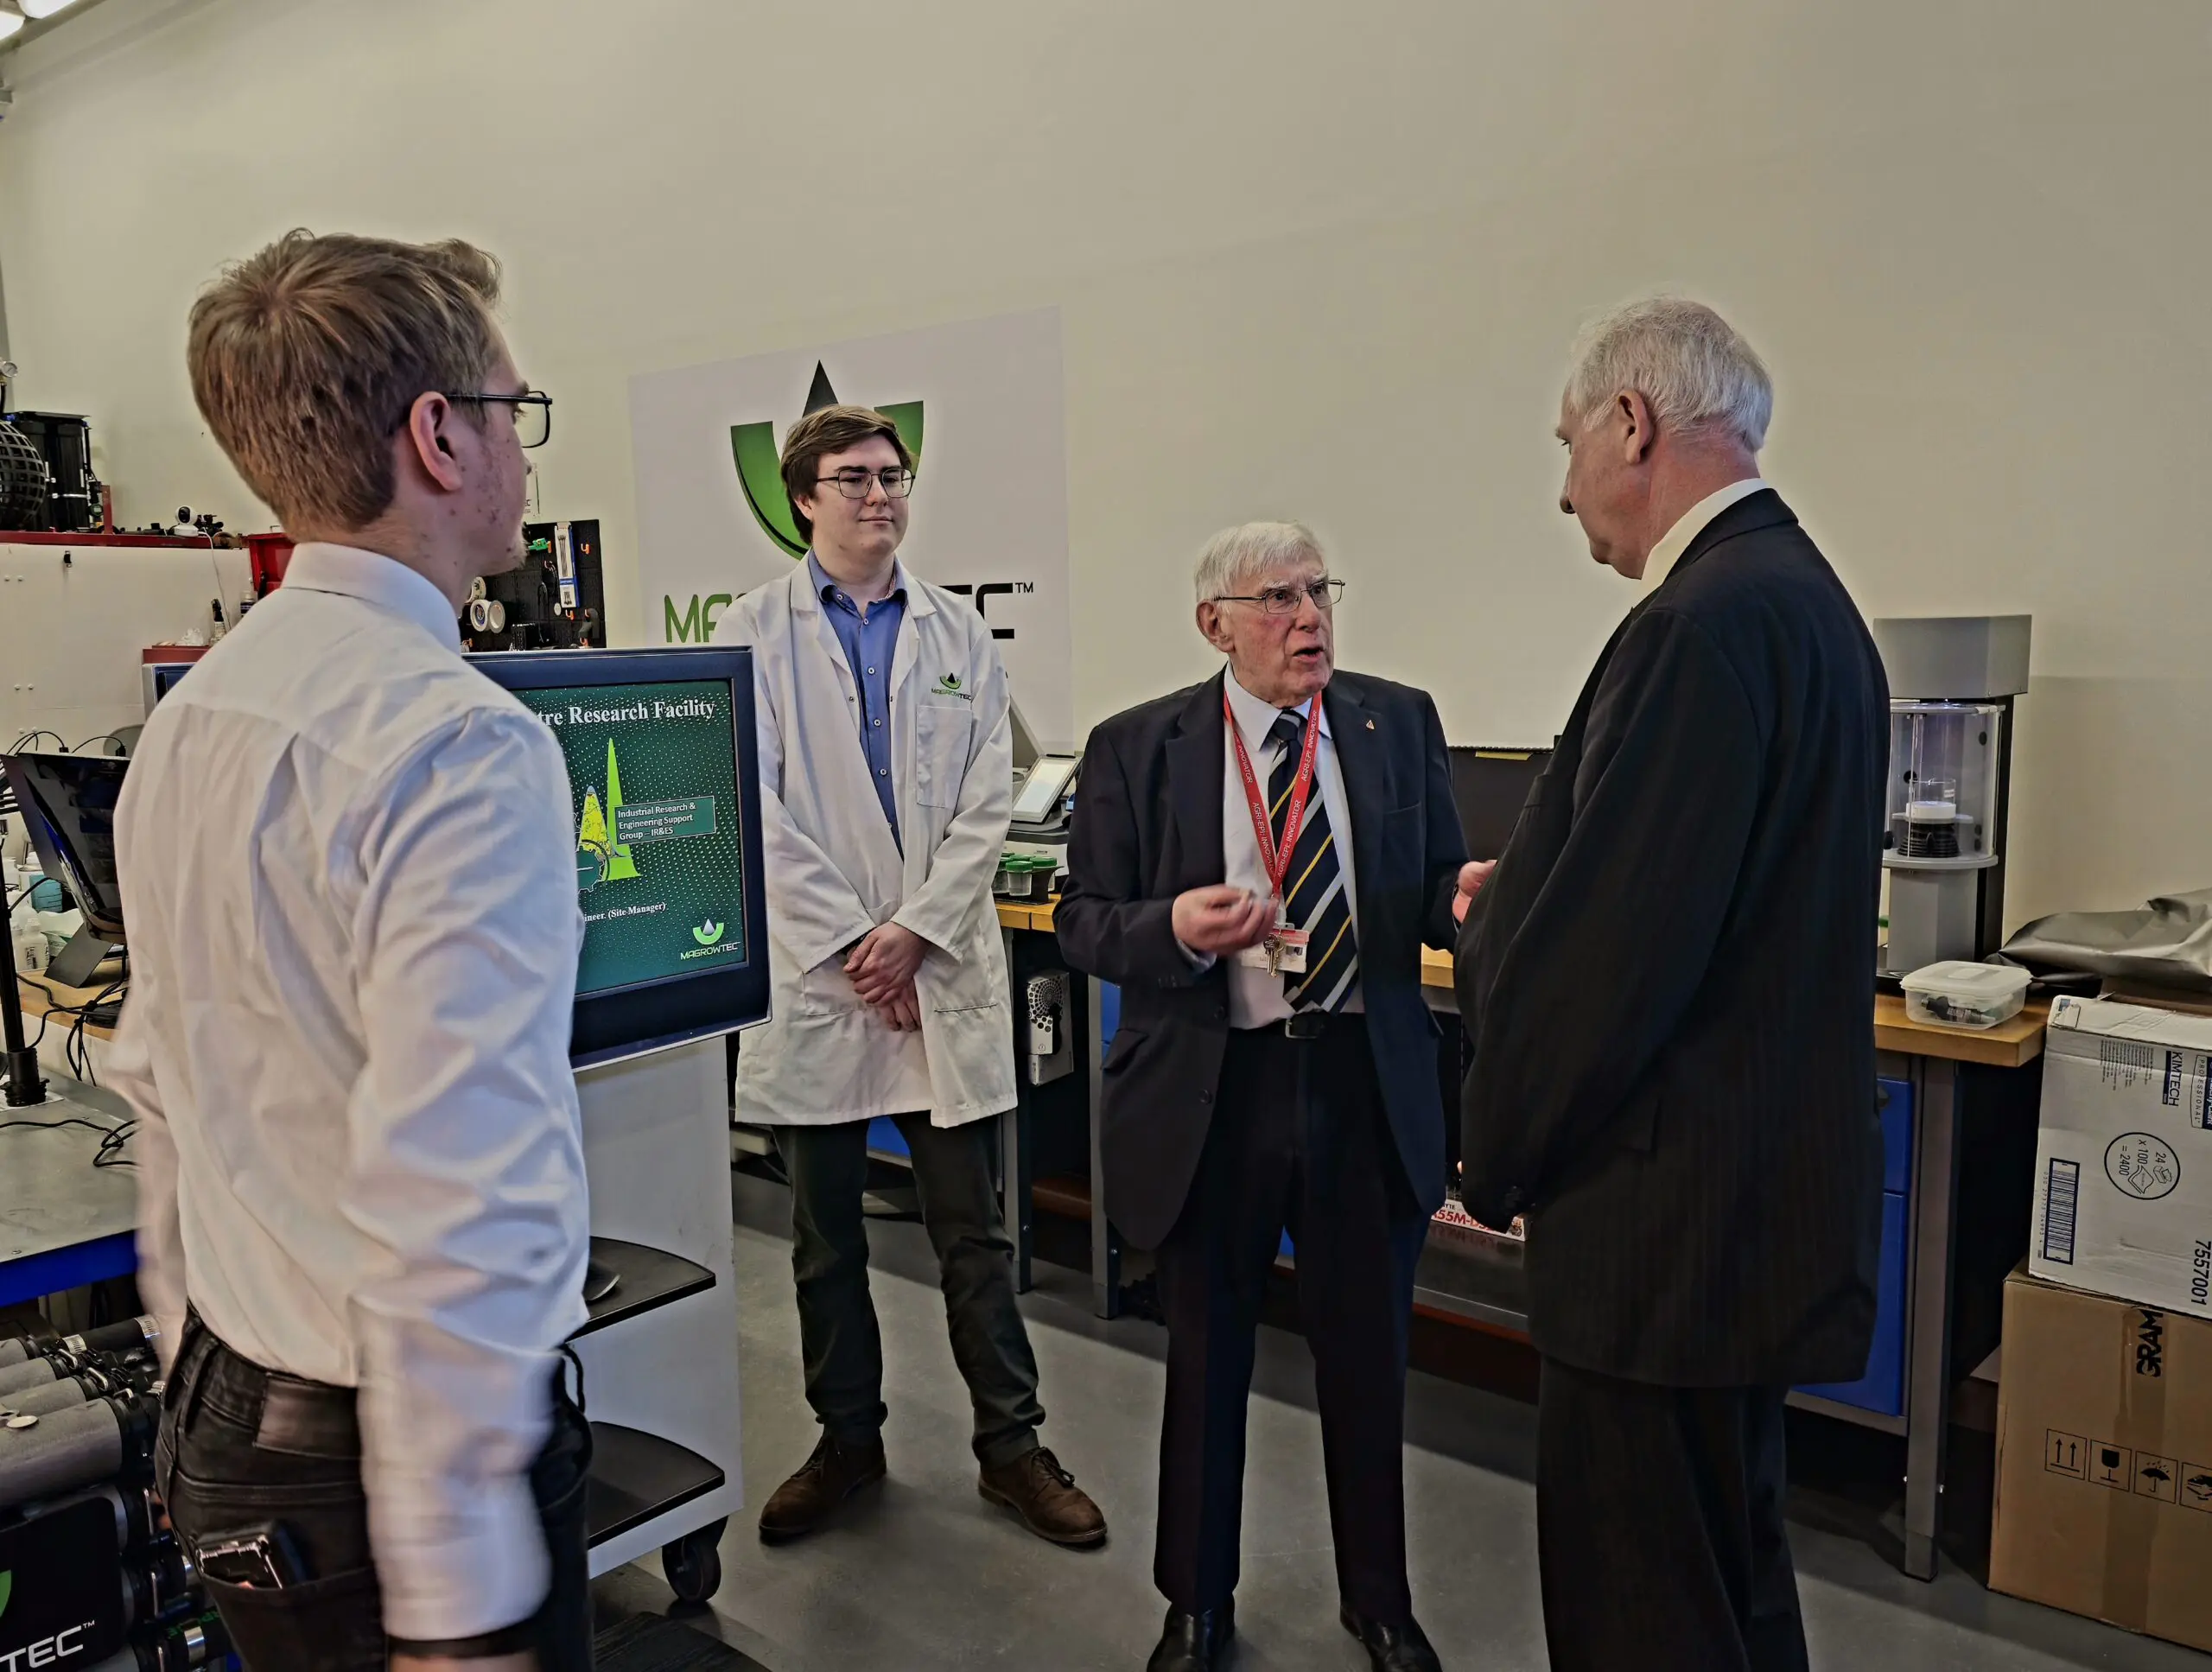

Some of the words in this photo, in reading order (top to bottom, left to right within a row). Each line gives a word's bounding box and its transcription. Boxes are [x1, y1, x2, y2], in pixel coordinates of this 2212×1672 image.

[537, 709, 563, 727] tre
[567, 702, 649, 724] Research
[652, 698, 715, 720] Facility
[1307, 709, 1317, 749] INNOVATOR
[1237, 745, 1253, 784] INNOVATOR
[618, 806, 654, 818] Industrial
[655, 803, 688, 813] Research
[619, 817, 663, 830] Engineering
[664, 814, 693, 824] Support
[1287, 799, 1301, 842] INNOVATOR
[651, 827, 673, 836] IR&ES
[582, 912, 607, 922] ineer.
[608, 908, 627, 920] (Site
[628, 902, 666, 914] Manager)
[2168, 1051, 2183, 1107] KIMTECH
[2119, 1154, 2131, 1176] 2400
[2137, 1149, 2148, 1165] 100
[2155, 1152, 2166, 1164] 24
[2190, 1240, 2212, 1306] 7557001
[2136, 1309, 2164, 1377] SRAM
